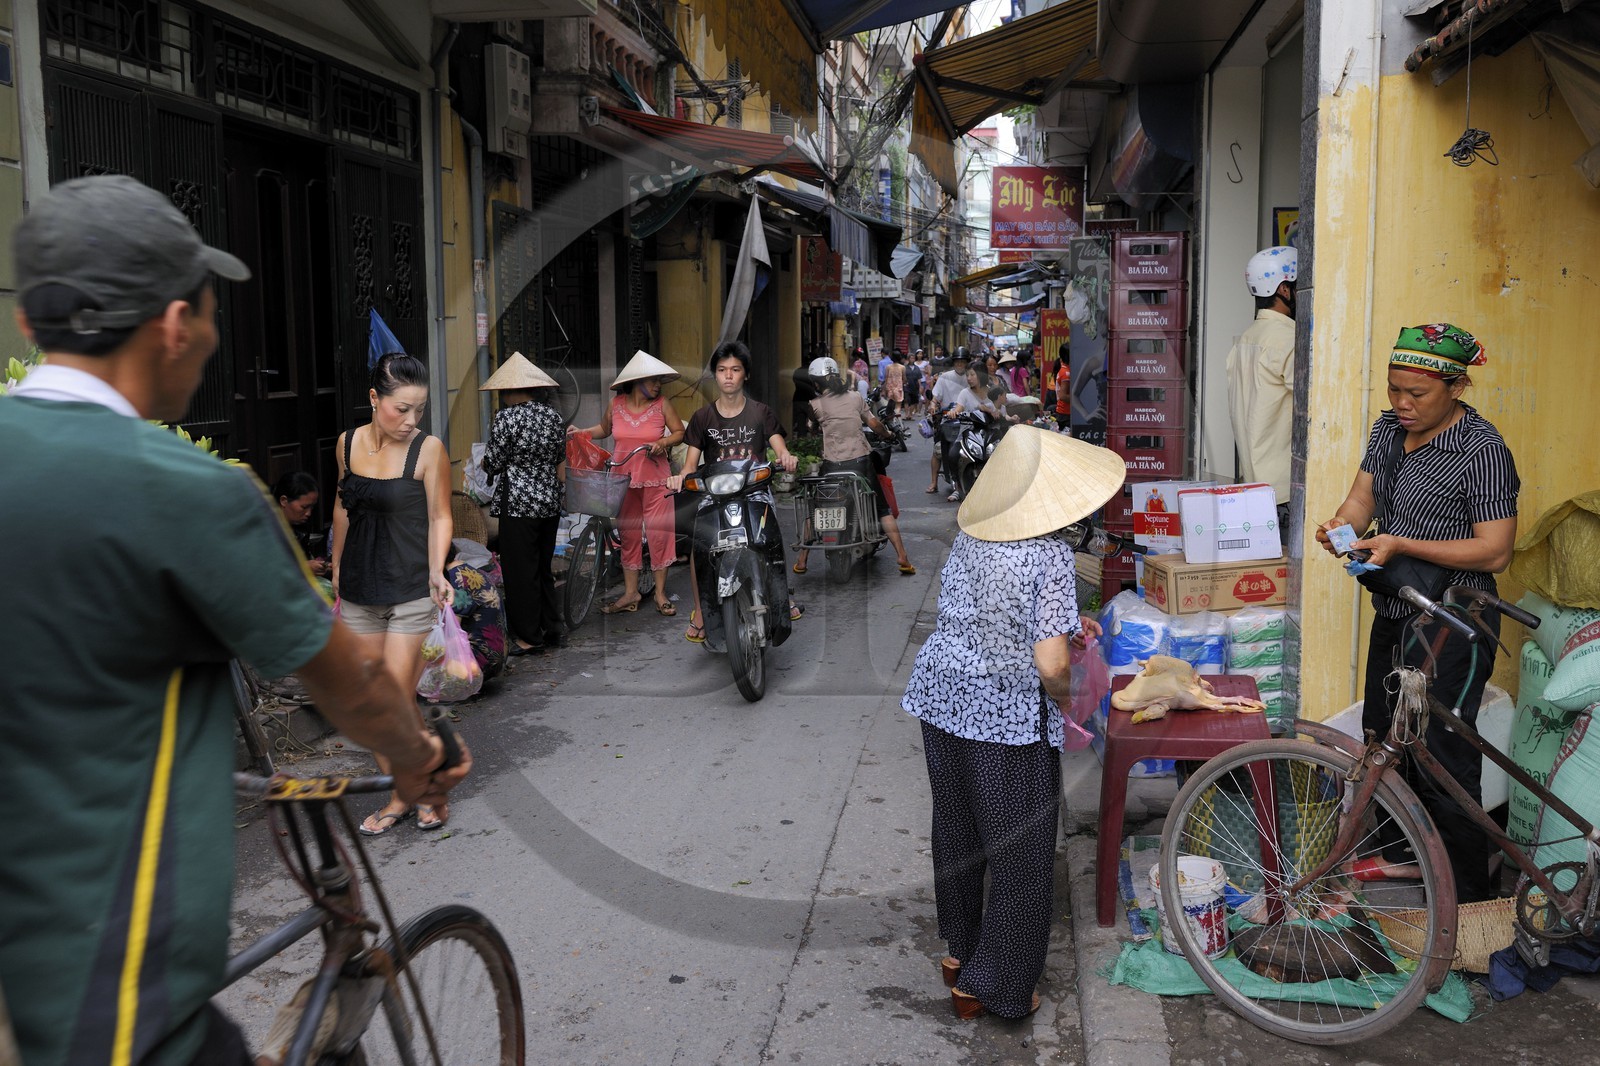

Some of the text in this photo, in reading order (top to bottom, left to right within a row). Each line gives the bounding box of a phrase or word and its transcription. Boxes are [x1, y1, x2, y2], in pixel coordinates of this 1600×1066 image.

[998, 174, 1077, 212] Mỹ Lộc
[995, 221, 1018, 231] MAY
[1034, 219, 1056, 231] BÁN
[1128, 265, 1168, 275] BIA HÀ NỘI
[1128, 315, 1168, 326] BIA HÀ NỘI
[1126, 363, 1166, 374] BIA HÀ NỘI
[1125, 412, 1165, 423] BIA HÀ NỘI
[1125, 460, 1165, 471] BIA HÀ NỘI
[819, 519, 841, 529] 3507
[1144, 514, 1169, 524] Neptune
